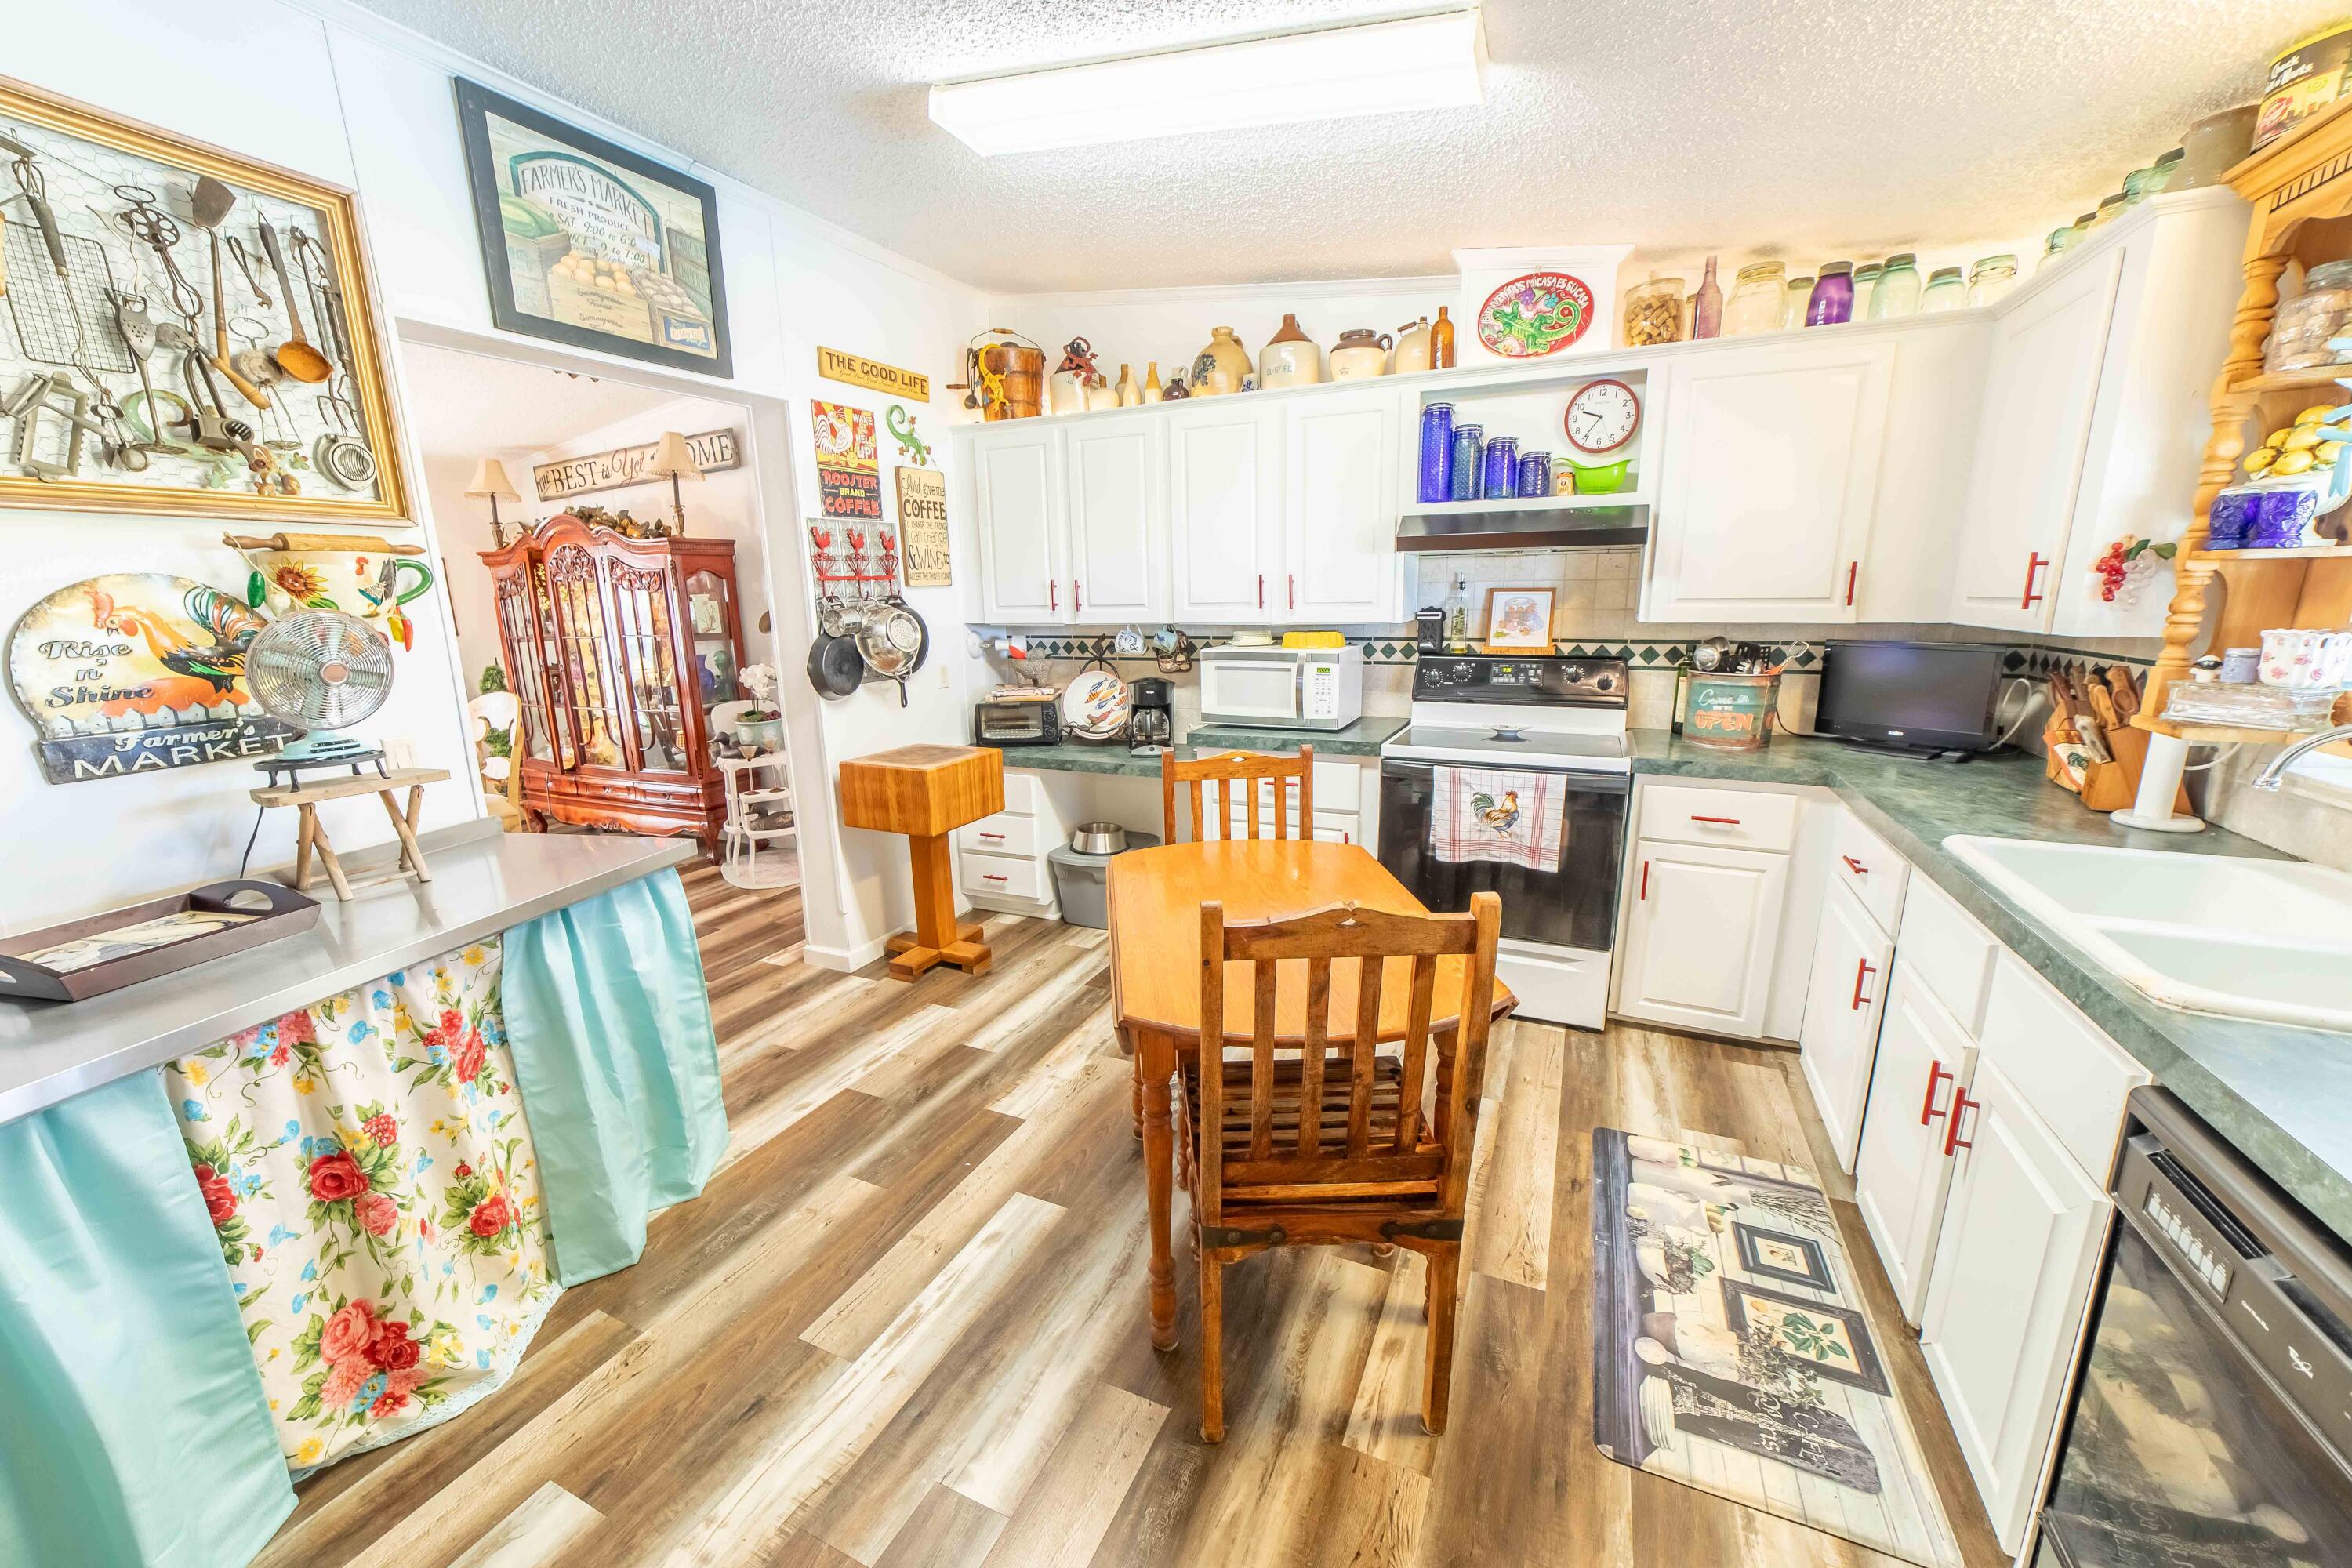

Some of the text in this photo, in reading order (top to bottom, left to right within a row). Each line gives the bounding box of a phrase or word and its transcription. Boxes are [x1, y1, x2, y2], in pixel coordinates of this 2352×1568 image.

[521, 164, 651, 241] FARMER'S MARKET
[550, 196, 584, 216] FRESH
[583, 221, 605, 237] 9:00
[826, 350, 928, 395] THE GOOD LIFE
[852, 413, 873, 426] WAKE
[855, 434, 874, 445] HELL
[1584, 434, 1590, 443] 7
[856, 445, 876, 460] UP!
[538, 471, 552, 493] THE
[552, 461, 597, 494] BEST
[601, 463, 612, 480] is
[611, 448, 645, 487] Yet
[685, 434, 733, 466] OME
[822, 470, 878, 490] ROOSTER
[923, 482, 935, 498] give
[936, 486, 945, 497] me
[839, 487, 866, 498] BRAND
[825, 496, 879, 516] COFFEE
[903, 498, 946, 520] COFFEE
[912, 521, 925, 529] CHANGE
[909, 544, 950, 571] & WINE to
[39, 640, 133, 659] Rise
[45, 684, 156, 709] Shine
[1698, 688, 1734, 706] Come
[1695, 710, 1755, 731] OPEN
[114, 716, 256, 752] Farmer's
[74, 732, 293, 779] MARKET
